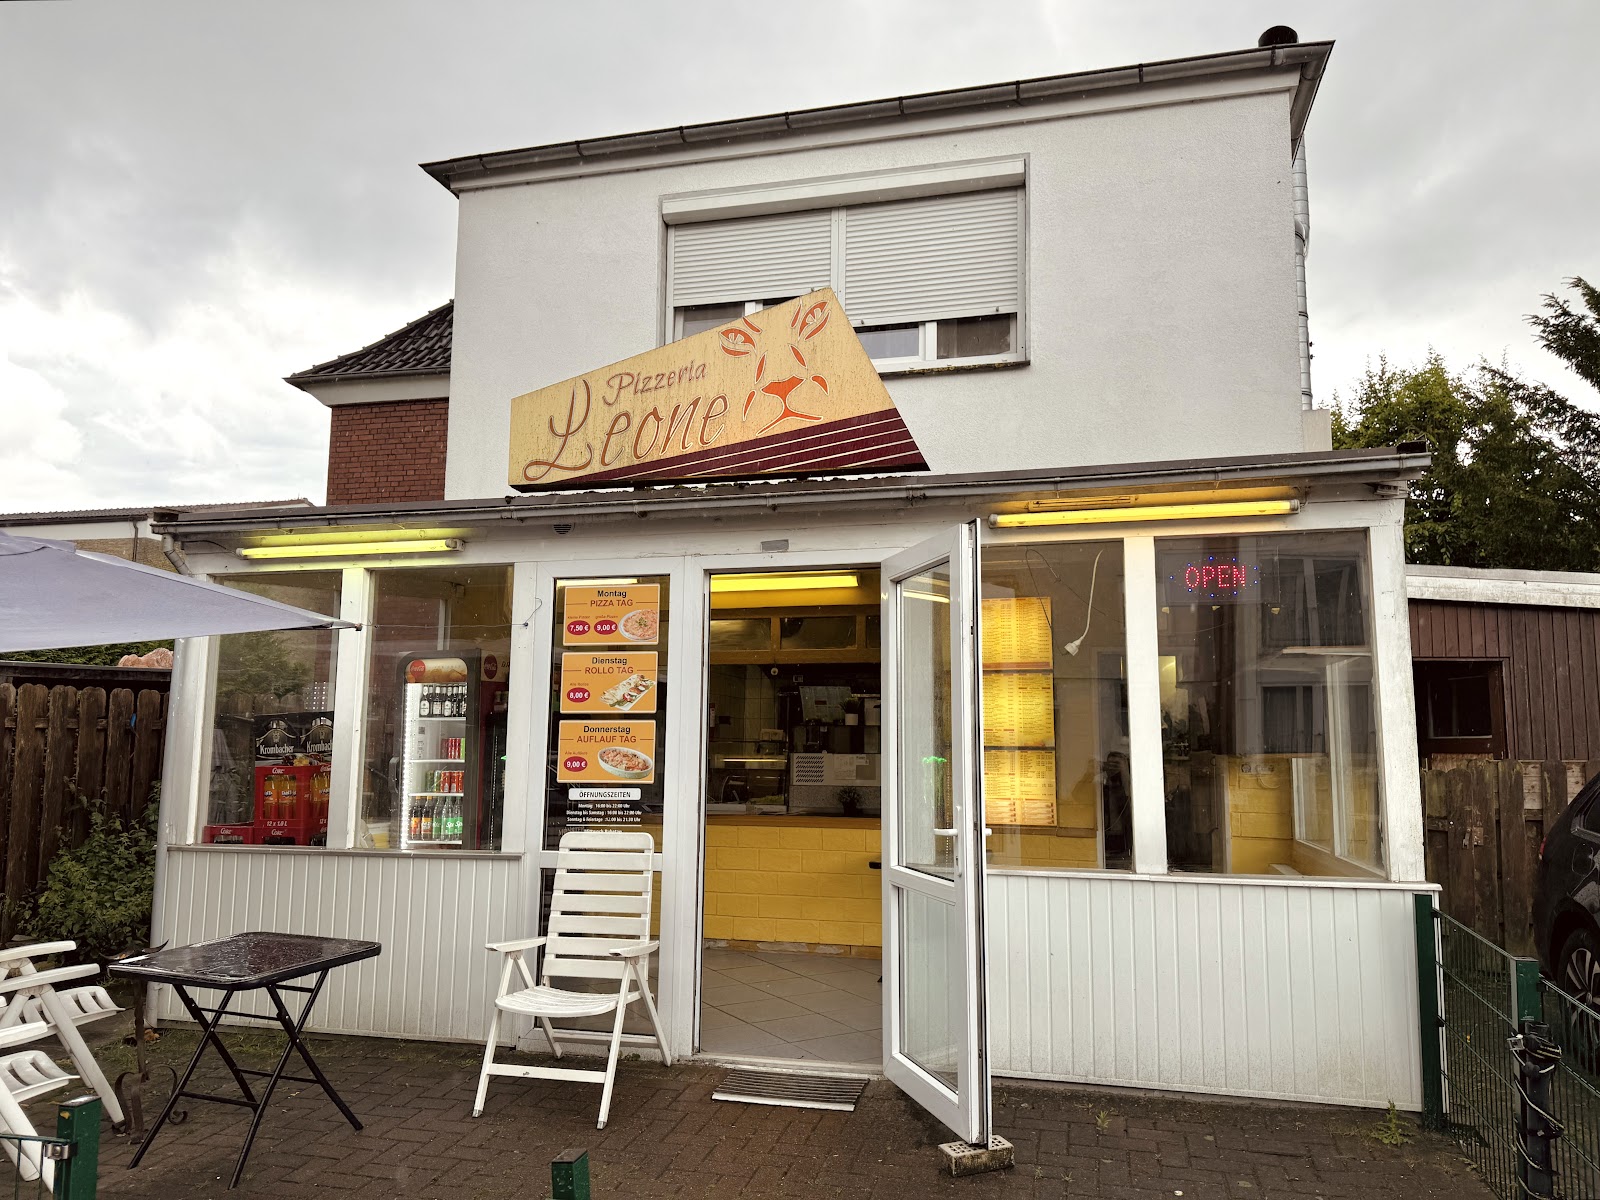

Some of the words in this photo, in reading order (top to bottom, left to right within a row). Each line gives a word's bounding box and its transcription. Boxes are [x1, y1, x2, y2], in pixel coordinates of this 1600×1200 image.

[602, 361, 707, 406] Pizzeria
[523, 379, 729, 482] Leone
[1185, 565, 1246, 588] OPEN
[597, 590, 627, 598] Montag
[591, 657, 628, 665] Dienstag
[616, 666, 634, 674] TAG
[583, 726, 631, 734] Donnerstag
[619, 735, 637, 743] TAG
[260, 743, 294, 754] Krombacher
[579, 790, 631, 798] ÖFFNUNGSZEITEN
